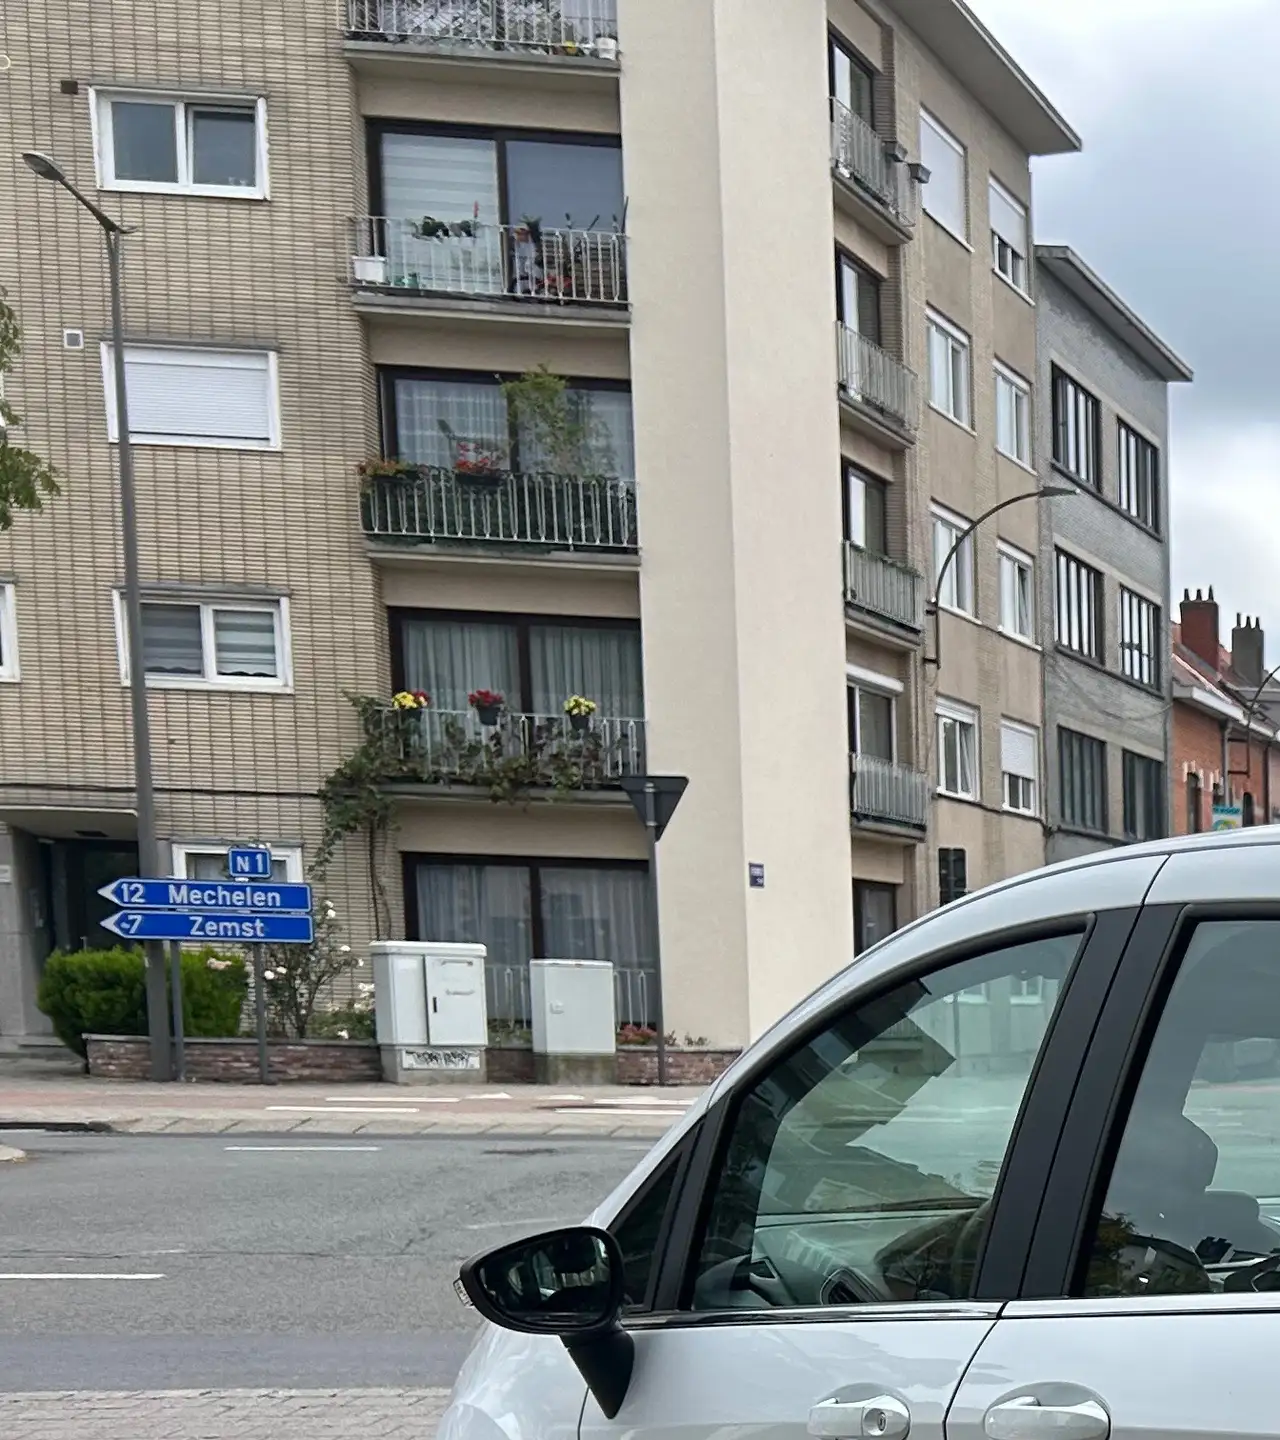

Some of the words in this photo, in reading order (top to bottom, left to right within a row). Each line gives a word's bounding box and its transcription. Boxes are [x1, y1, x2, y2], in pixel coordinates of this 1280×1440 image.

[236, 856, 249, 872] N
[256, 853, 264, 873] 1
[120, 883, 145, 903] 12
[168, 884, 280, 907] Mechelen
[189, 916, 265, 937] Zemst
